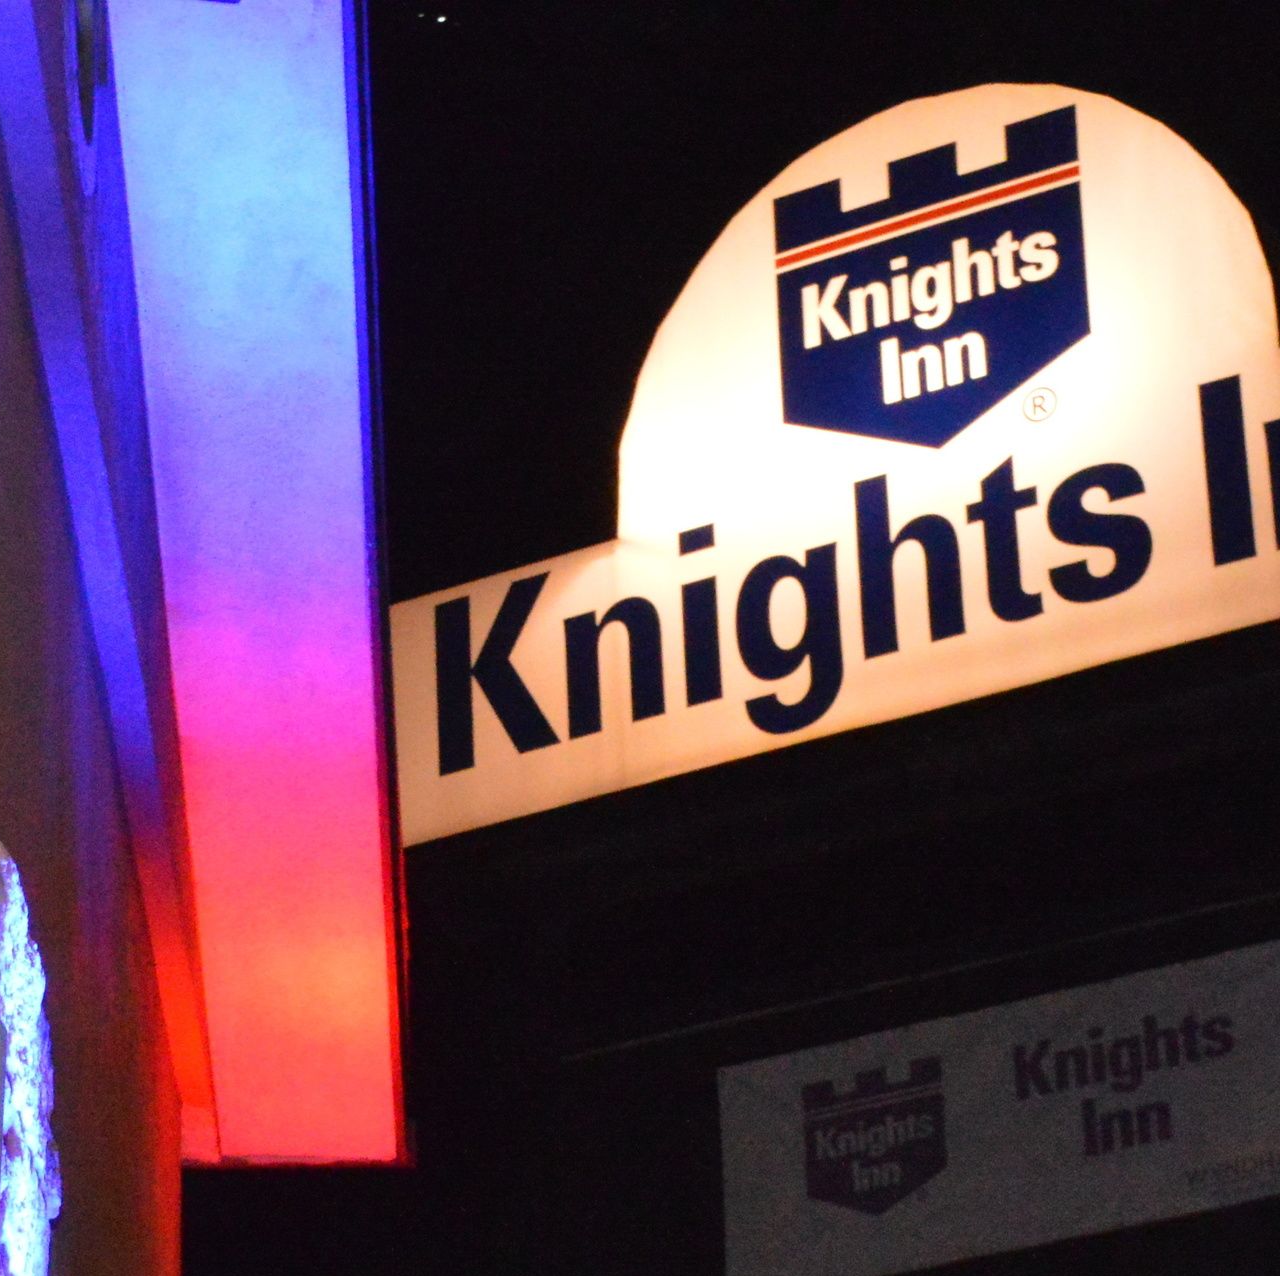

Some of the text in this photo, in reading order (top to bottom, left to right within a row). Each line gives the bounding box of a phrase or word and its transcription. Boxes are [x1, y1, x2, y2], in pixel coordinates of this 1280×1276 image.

[800, 221, 1060, 349] Knights
[879, 330, 987, 407] Inn
[433, 454, 1154, 736] Knights
[1012, 1011, 1235, 1099] Knights
[814, 1111, 934, 1160] Knights
[1081, 1098, 1173, 1157] Inn
[851, 1156, 903, 1193] Inn
